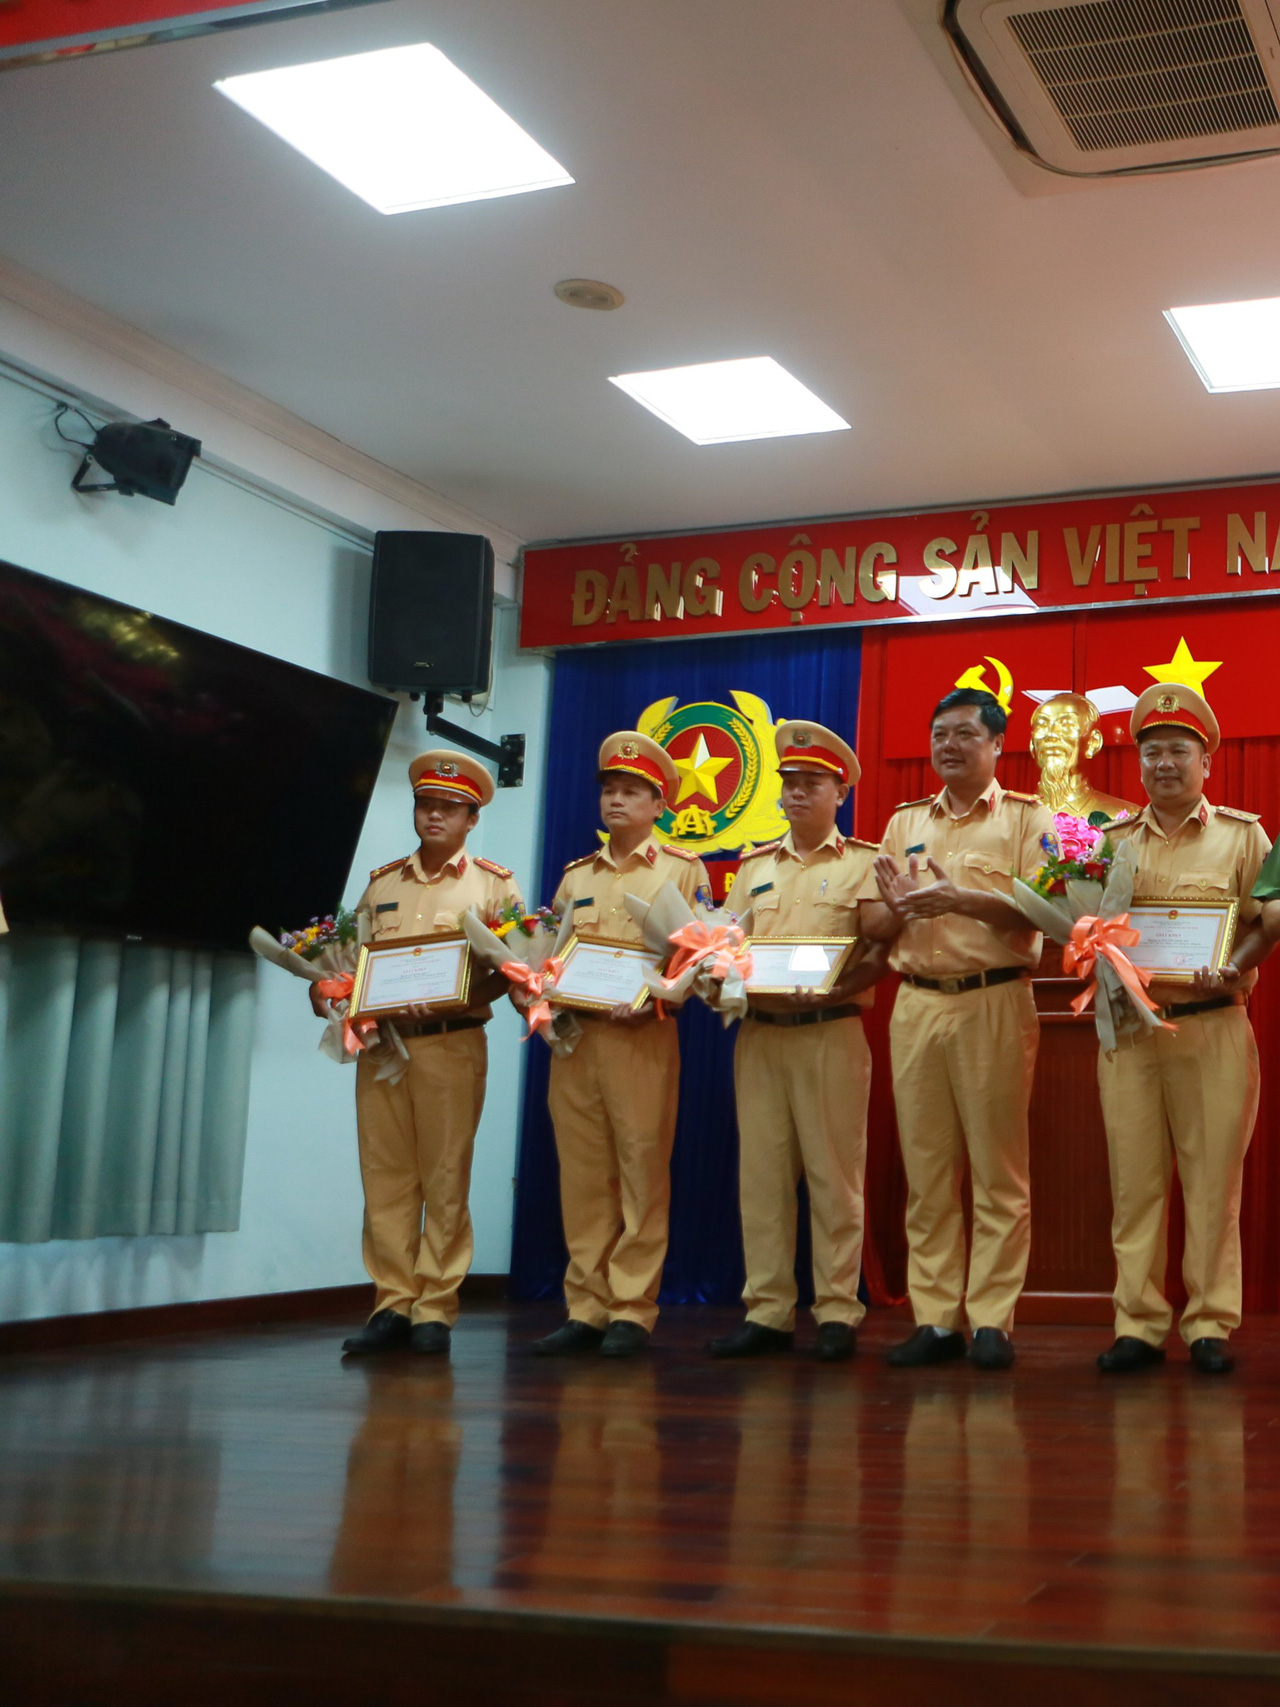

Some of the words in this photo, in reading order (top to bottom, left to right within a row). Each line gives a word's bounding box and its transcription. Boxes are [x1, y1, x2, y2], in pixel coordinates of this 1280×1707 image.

[571, 543, 723, 627] ĐẢNG
[739, 534, 898, 622] CỘNG
[919, 511, 1039, 600] SẢN
[1063, 503, 1200, 596] VIỆT
